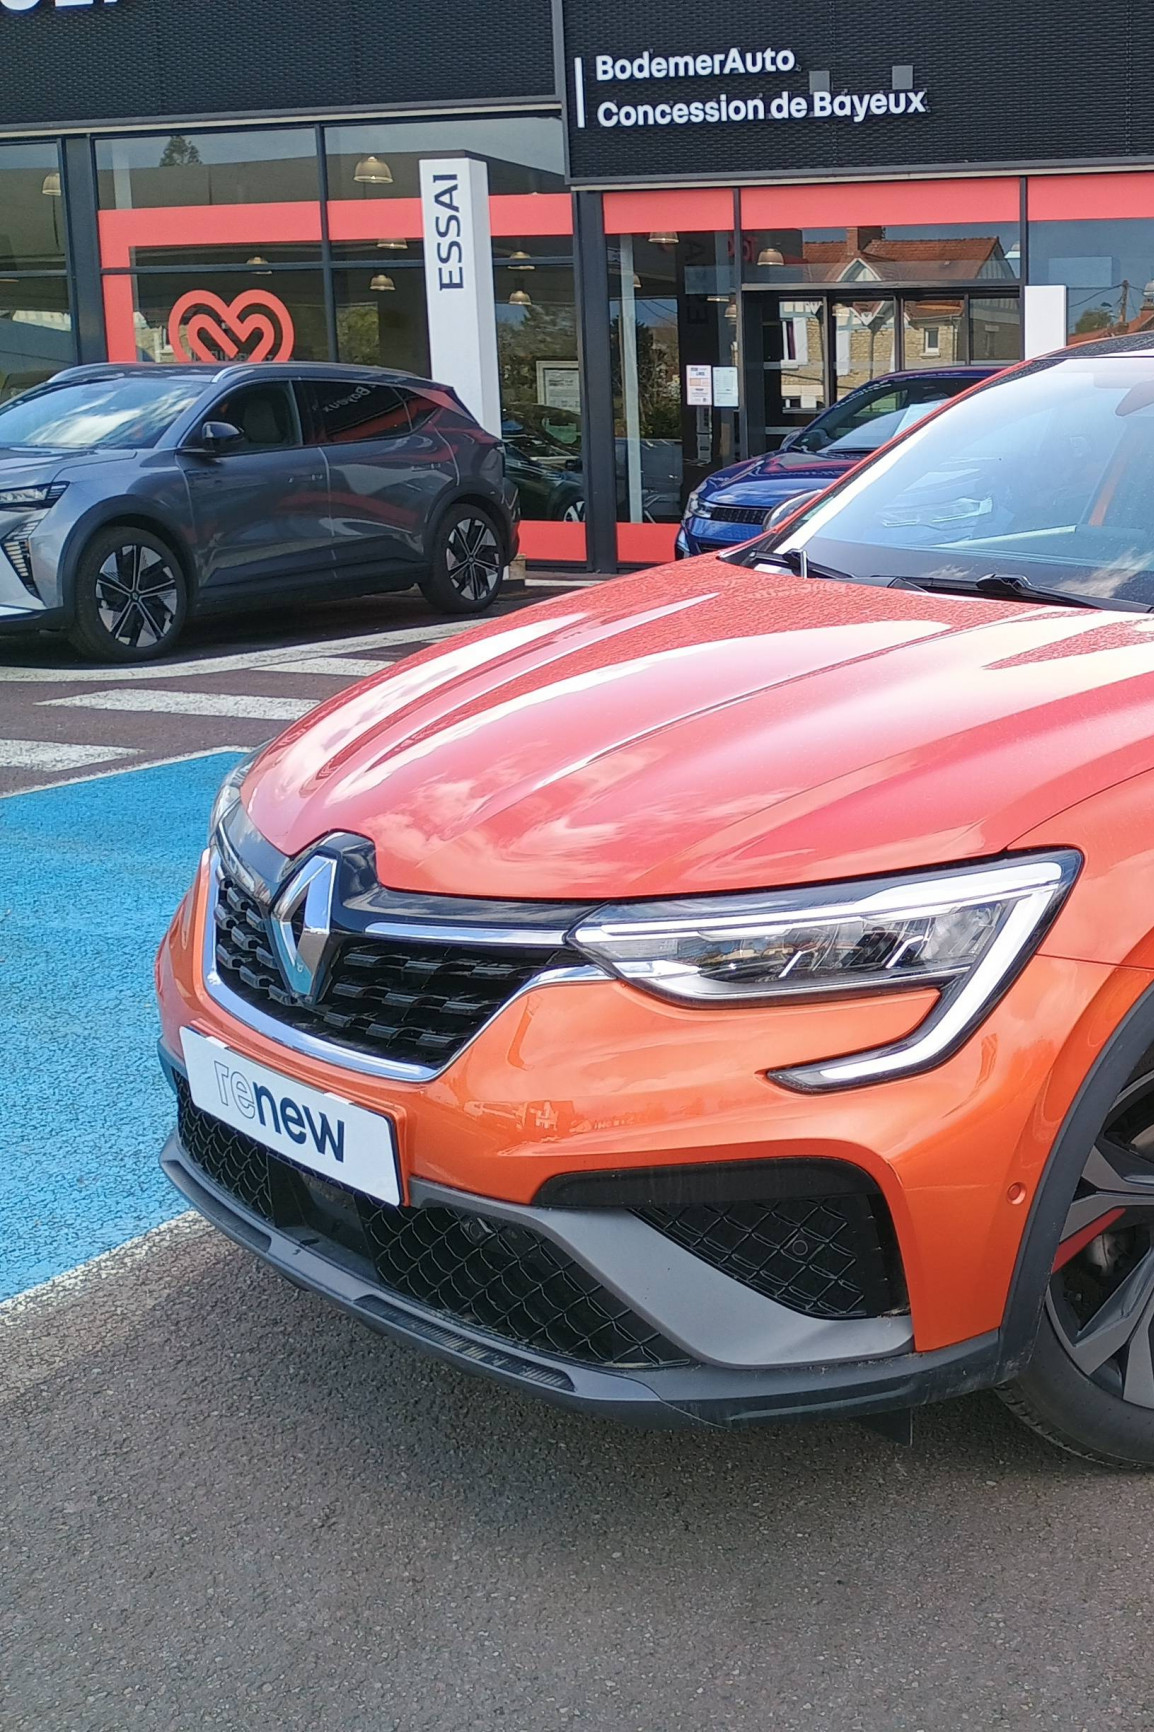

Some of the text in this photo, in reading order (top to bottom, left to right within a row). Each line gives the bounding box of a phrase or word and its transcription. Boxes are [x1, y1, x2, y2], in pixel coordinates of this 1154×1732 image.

[595, 48, 796, 81] BodemerAuto
[597, 91, 927, 127] Concession de Bayeux
[433, 174, 464, 291] ESSAI
[214, 1060, 345, 1163] renew
